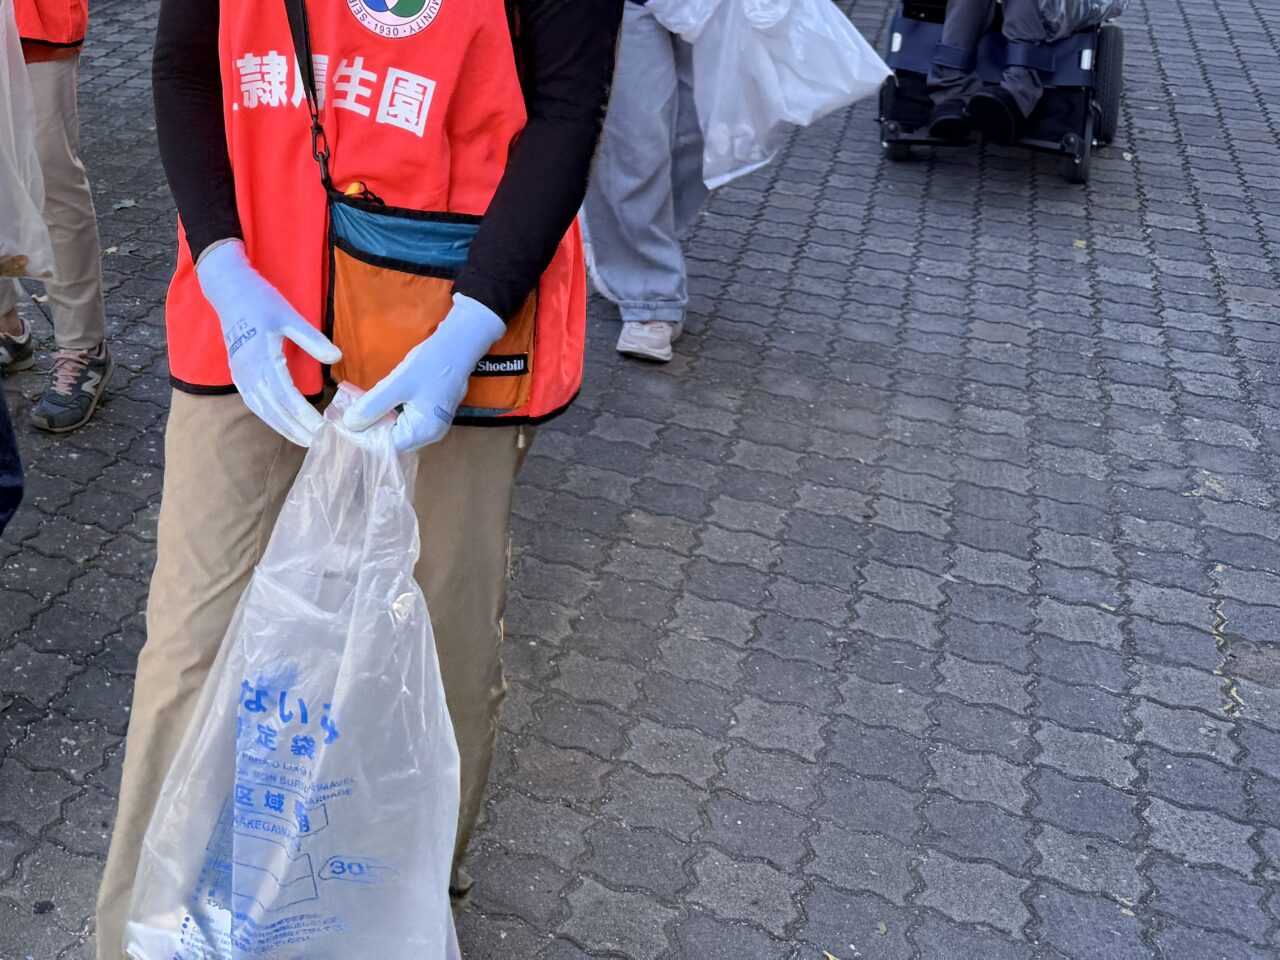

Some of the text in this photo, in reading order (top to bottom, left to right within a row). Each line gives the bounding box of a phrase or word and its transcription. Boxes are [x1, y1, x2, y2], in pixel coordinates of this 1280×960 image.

[373, 23, 400, 37] 1930
[233, 50, 437, 138] 隷厚生園
[477, 359, 524, 371] Shoebill
[329, 860, 366, 876] 30
